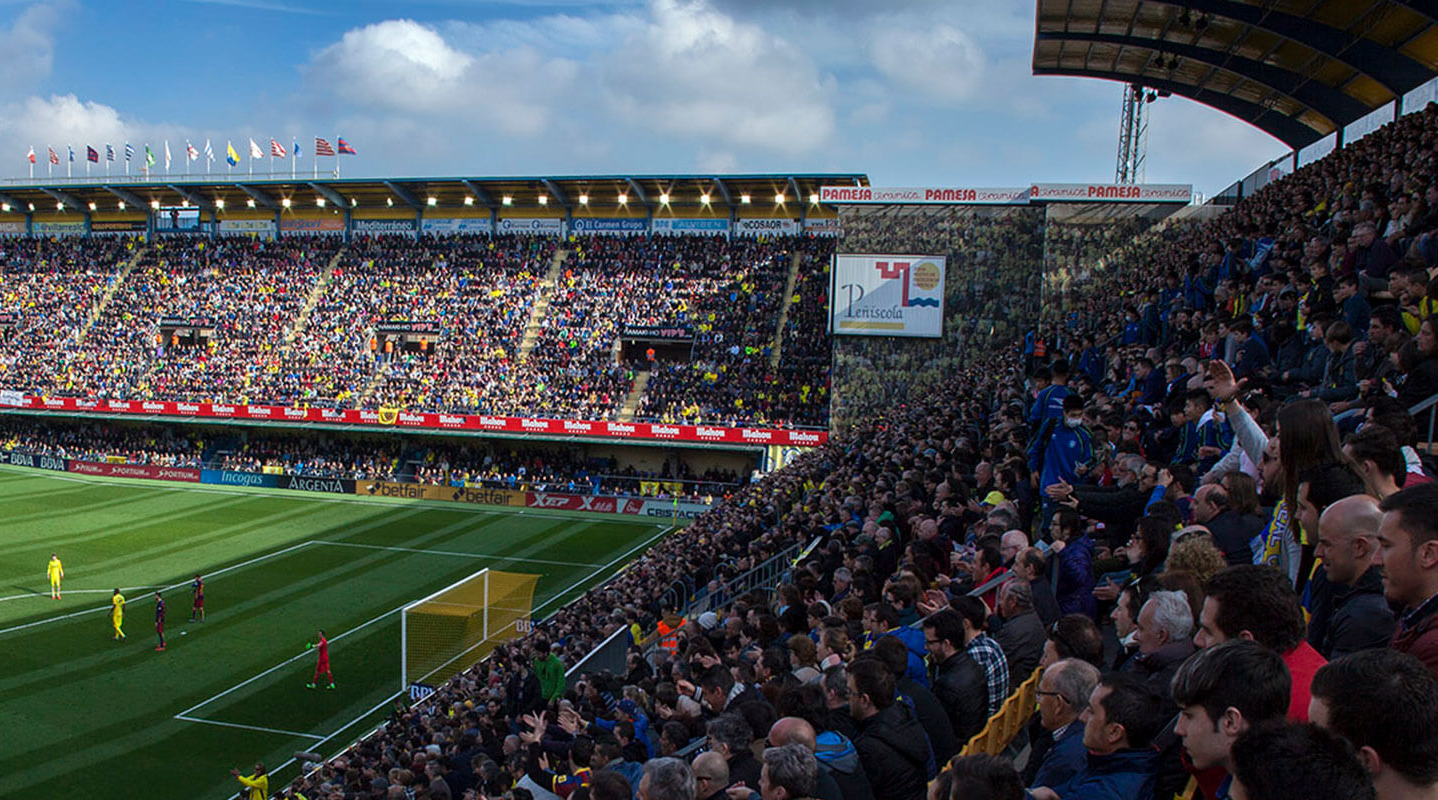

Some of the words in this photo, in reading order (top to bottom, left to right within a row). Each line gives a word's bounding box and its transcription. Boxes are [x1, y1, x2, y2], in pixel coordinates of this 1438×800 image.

[822, 189, 872, 200] PAMESA
[925, 189, 976, 200] PAMESA
[1088, 186, 1140, 198] PAMESA
[248, 406, 271, 415] Mahou
[399, 412, 424, 422] Mahou
[480, 416, 506, 426] Mahou
[522, 418, 548, 428] Mahou
[564, 420, 591, 430] Mahou
[607, 422, 635, 432] Mahou
[651, 424, 680, 435] Mahou
[696, 426, 725, 437] Mahou
[742, 428, 772, 440] Mahou
[789, 431, 819, 442] Mahou
[10, 452, 34, 467] BBVA
[40, 456, 65, 471] BBVA
[221, 470, 262, 486] Incogas
[288, 477, 344, 493] ARGENTA
[381, 483, 426, 499] betfair
[466, 488, 512, 506] betfair
